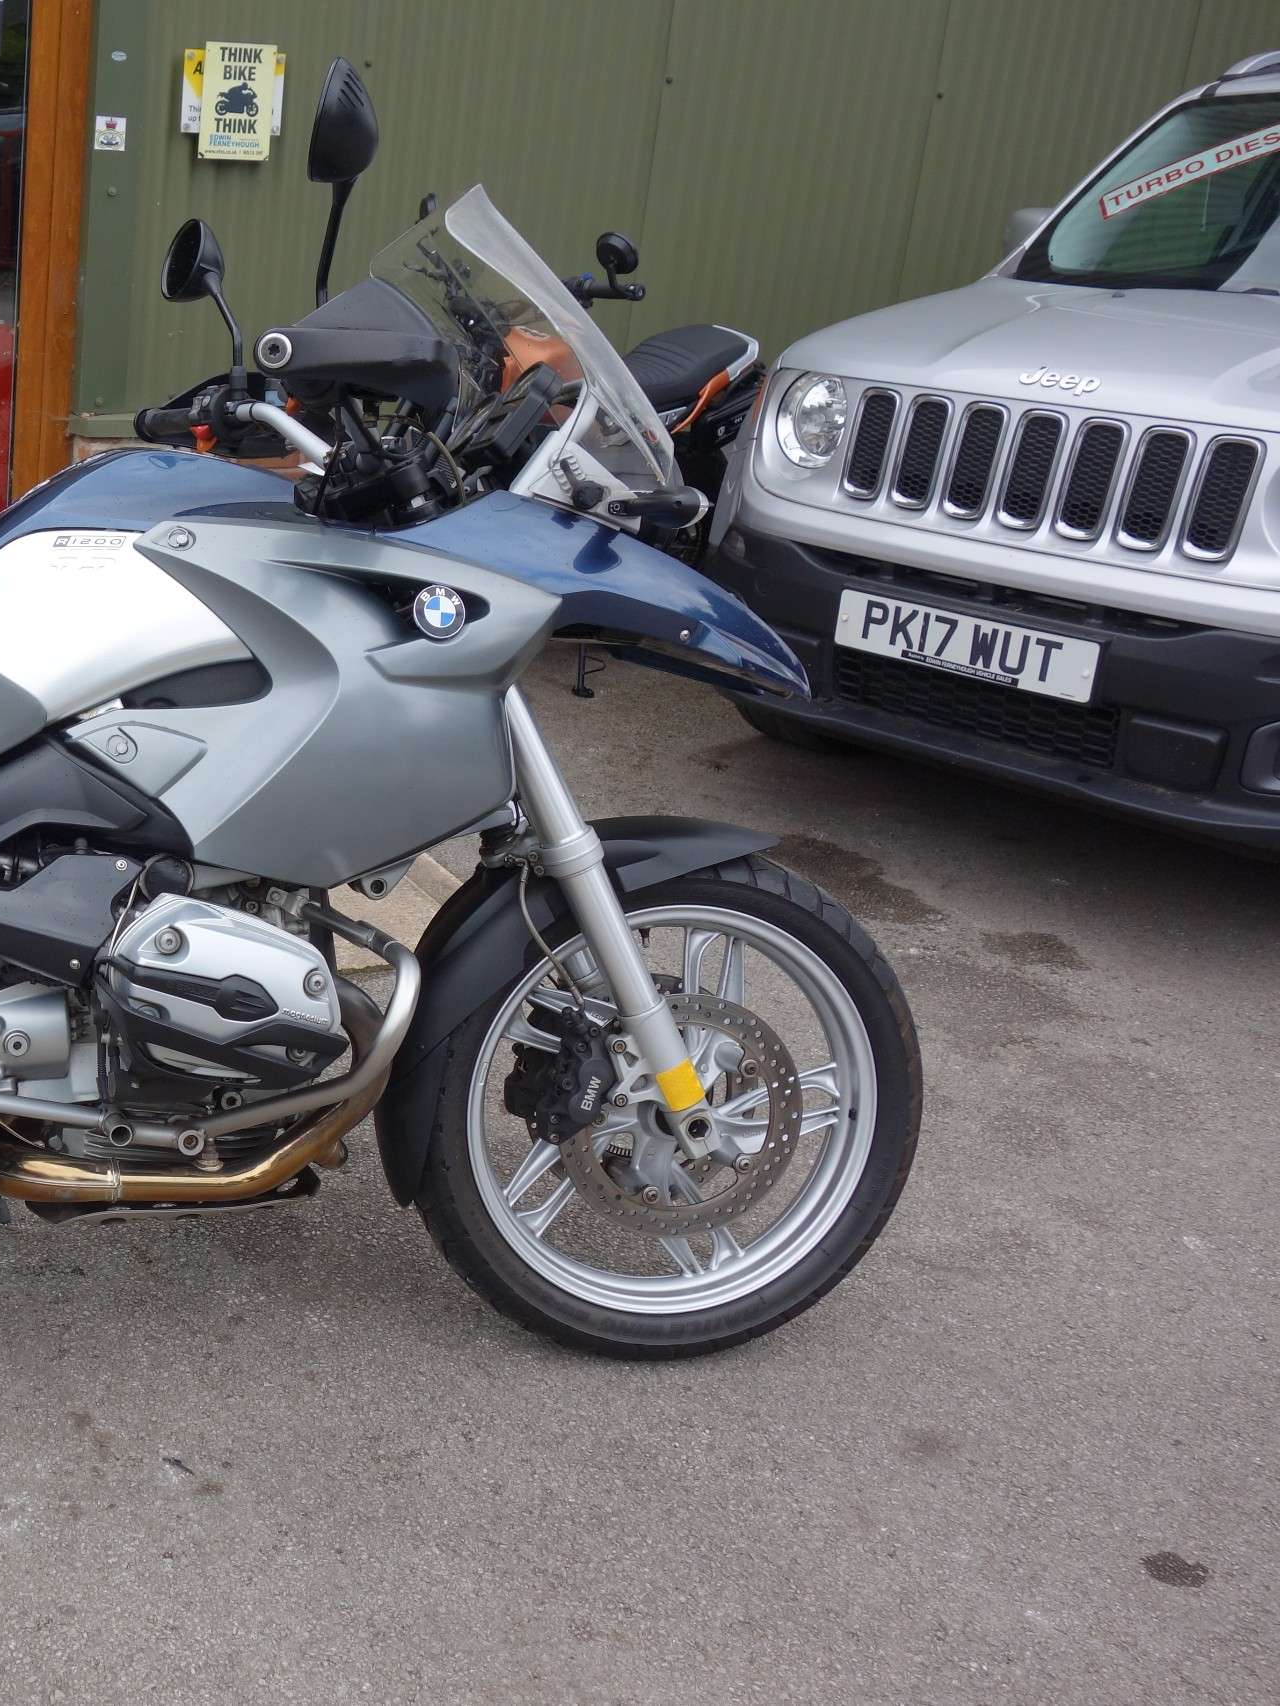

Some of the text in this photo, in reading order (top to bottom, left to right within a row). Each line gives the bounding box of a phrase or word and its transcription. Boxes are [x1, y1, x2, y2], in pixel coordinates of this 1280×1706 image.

[220, 47, 263, 64] THINK
[193, 61, 205, 75] A
[223, 65, 257, 81] BIKE
[214, 118, 257, 134] THINK
[1108, 160, 1205, 206] TURBO
[1019, 366, 1101, 396] Jeep
[52, 535, 127, 548] R1200
[420, 588, 461, 606] BMW
[861, 599, 1064, 683] PK17 WUT
[975, 670, 996, 680] VEHICLE
[995, 675, 1012, 684] SALES
[580, 1076, 601, 1111] BMW
